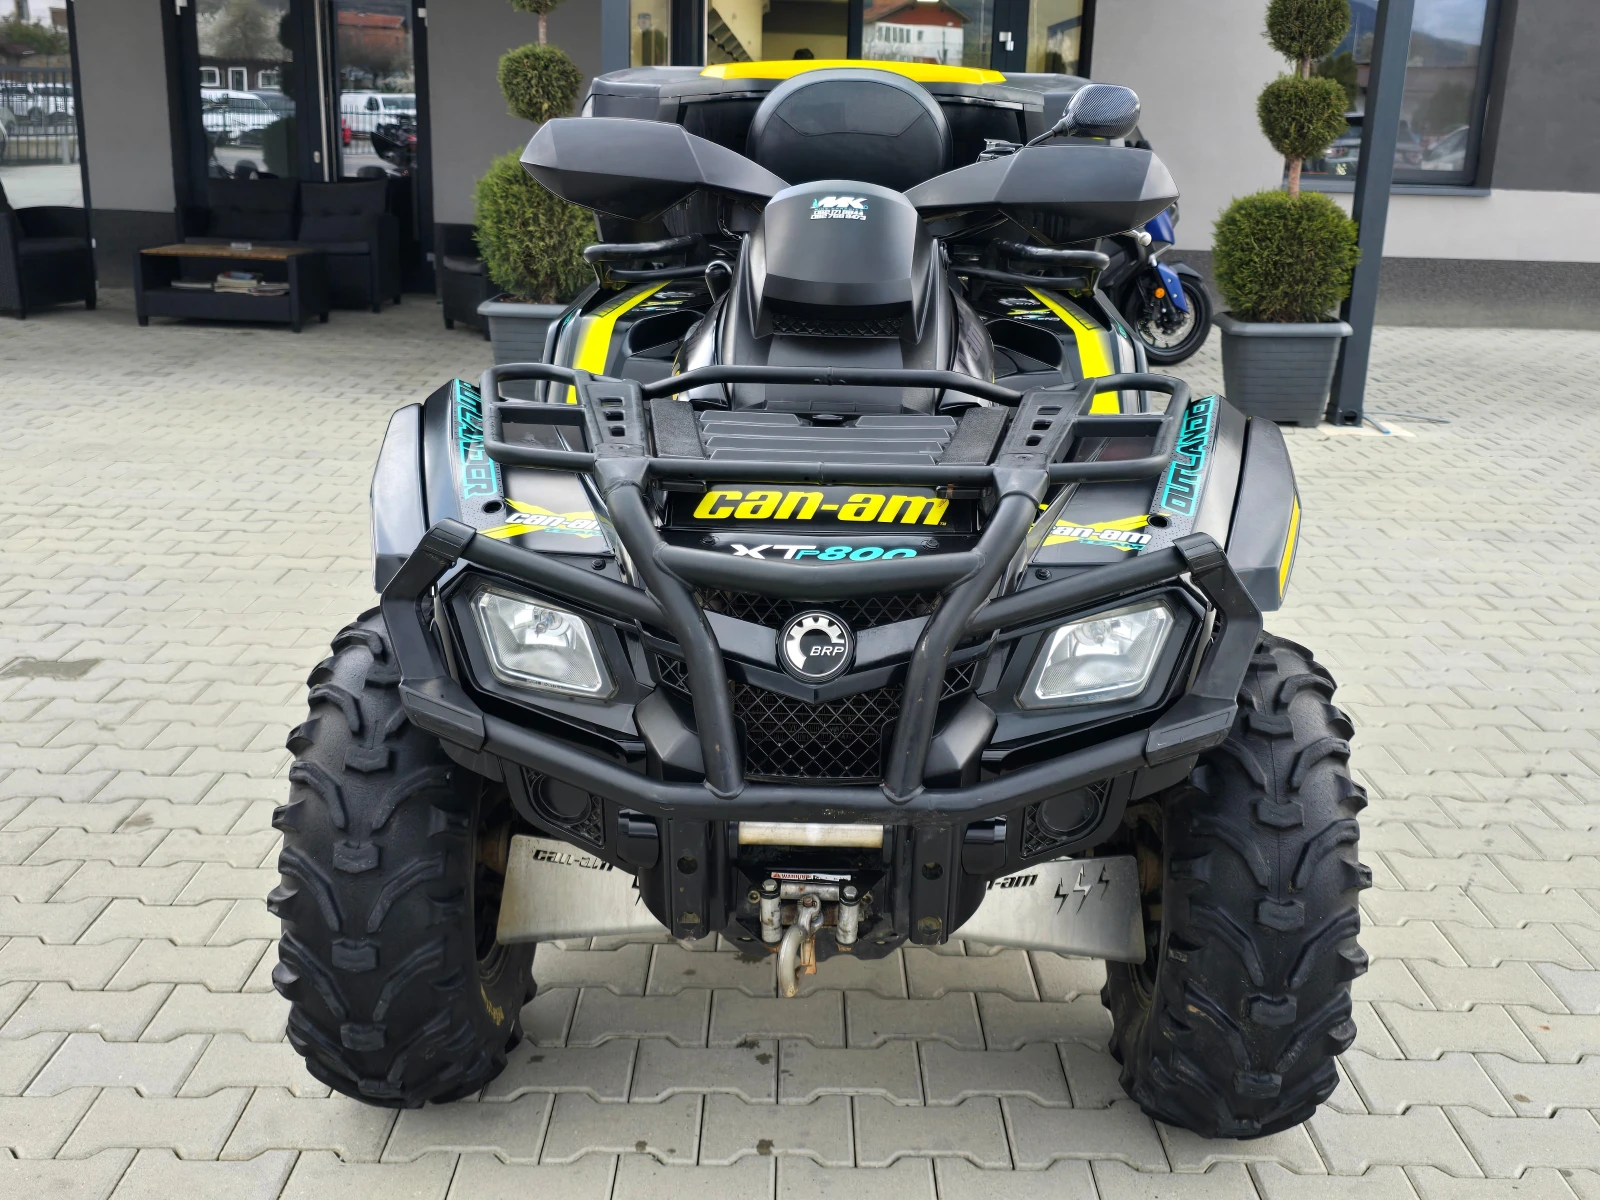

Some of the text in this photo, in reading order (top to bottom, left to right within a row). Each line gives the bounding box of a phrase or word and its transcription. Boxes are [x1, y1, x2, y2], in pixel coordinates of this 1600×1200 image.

[693, 490, 949, 525] can-am
[1051, 526, 1153, 545] an-am
[810, 645, 844, 656] BRP
